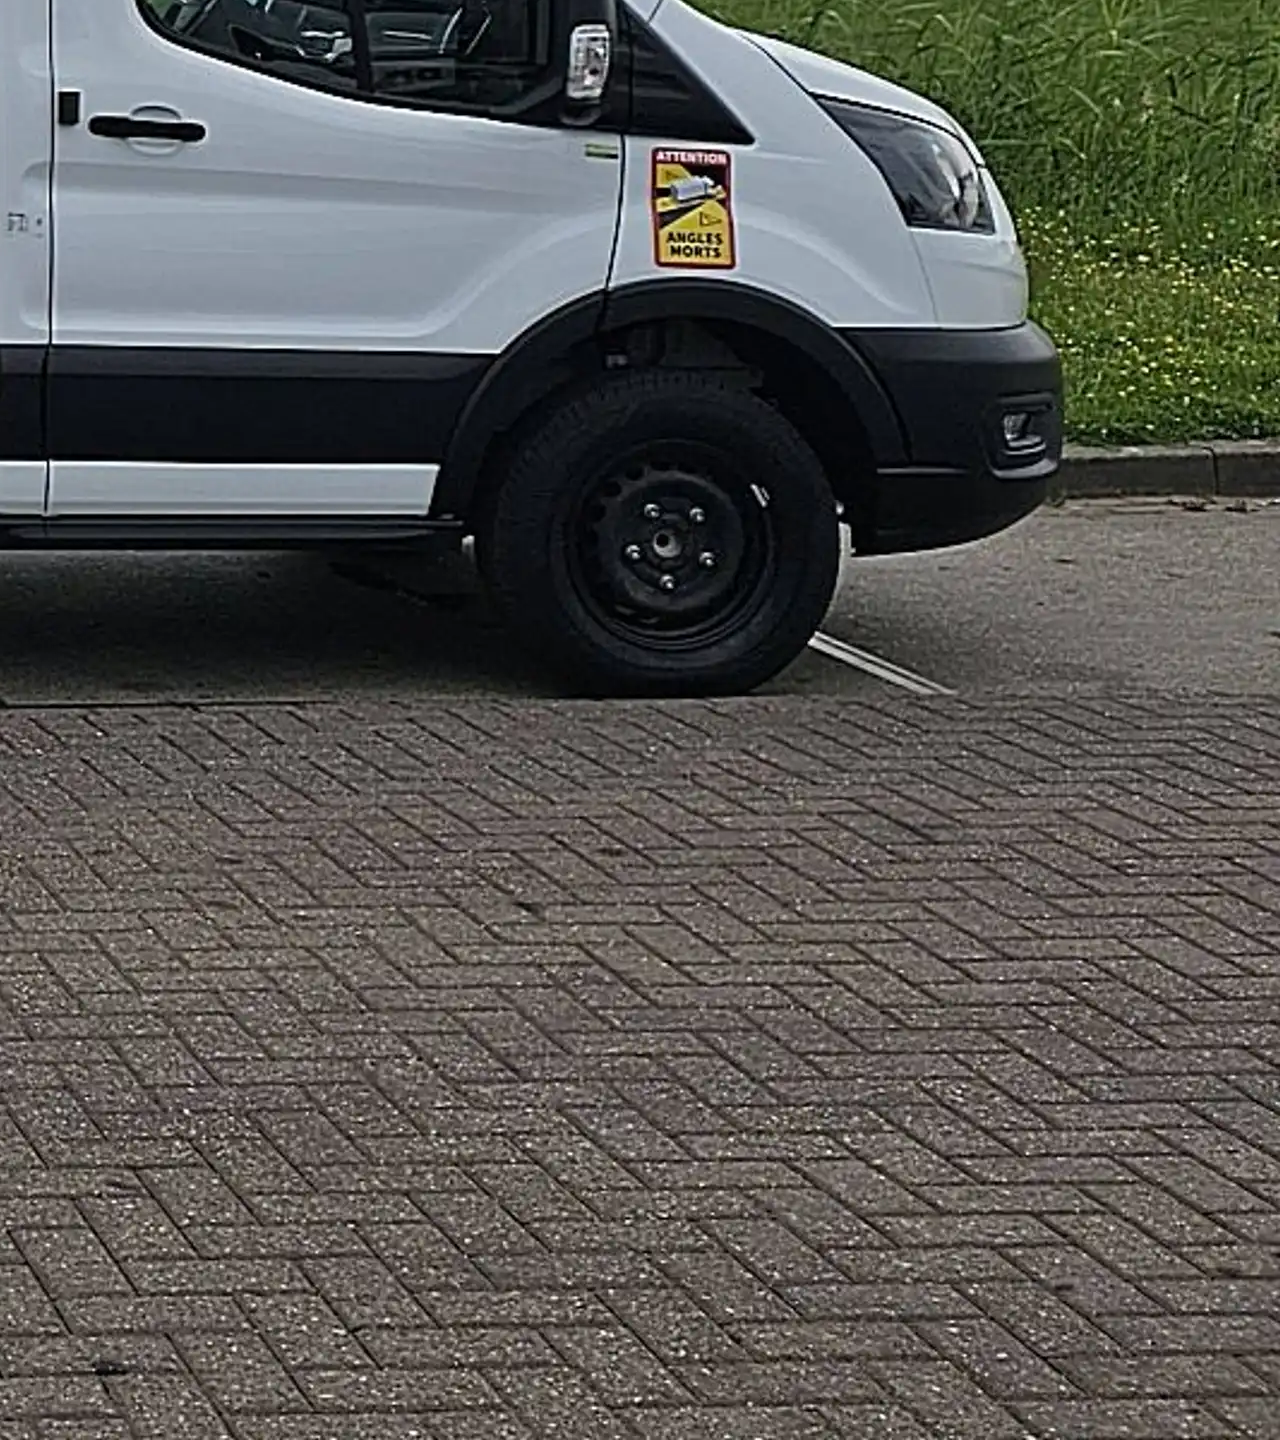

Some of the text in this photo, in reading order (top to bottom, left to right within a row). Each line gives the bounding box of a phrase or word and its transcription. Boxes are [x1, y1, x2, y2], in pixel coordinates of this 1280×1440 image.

[656, 151, 727, 164] ATTENTION
[666, 231, 723, 244] ANGLES
[670, 245, 721, 258] MORTS
